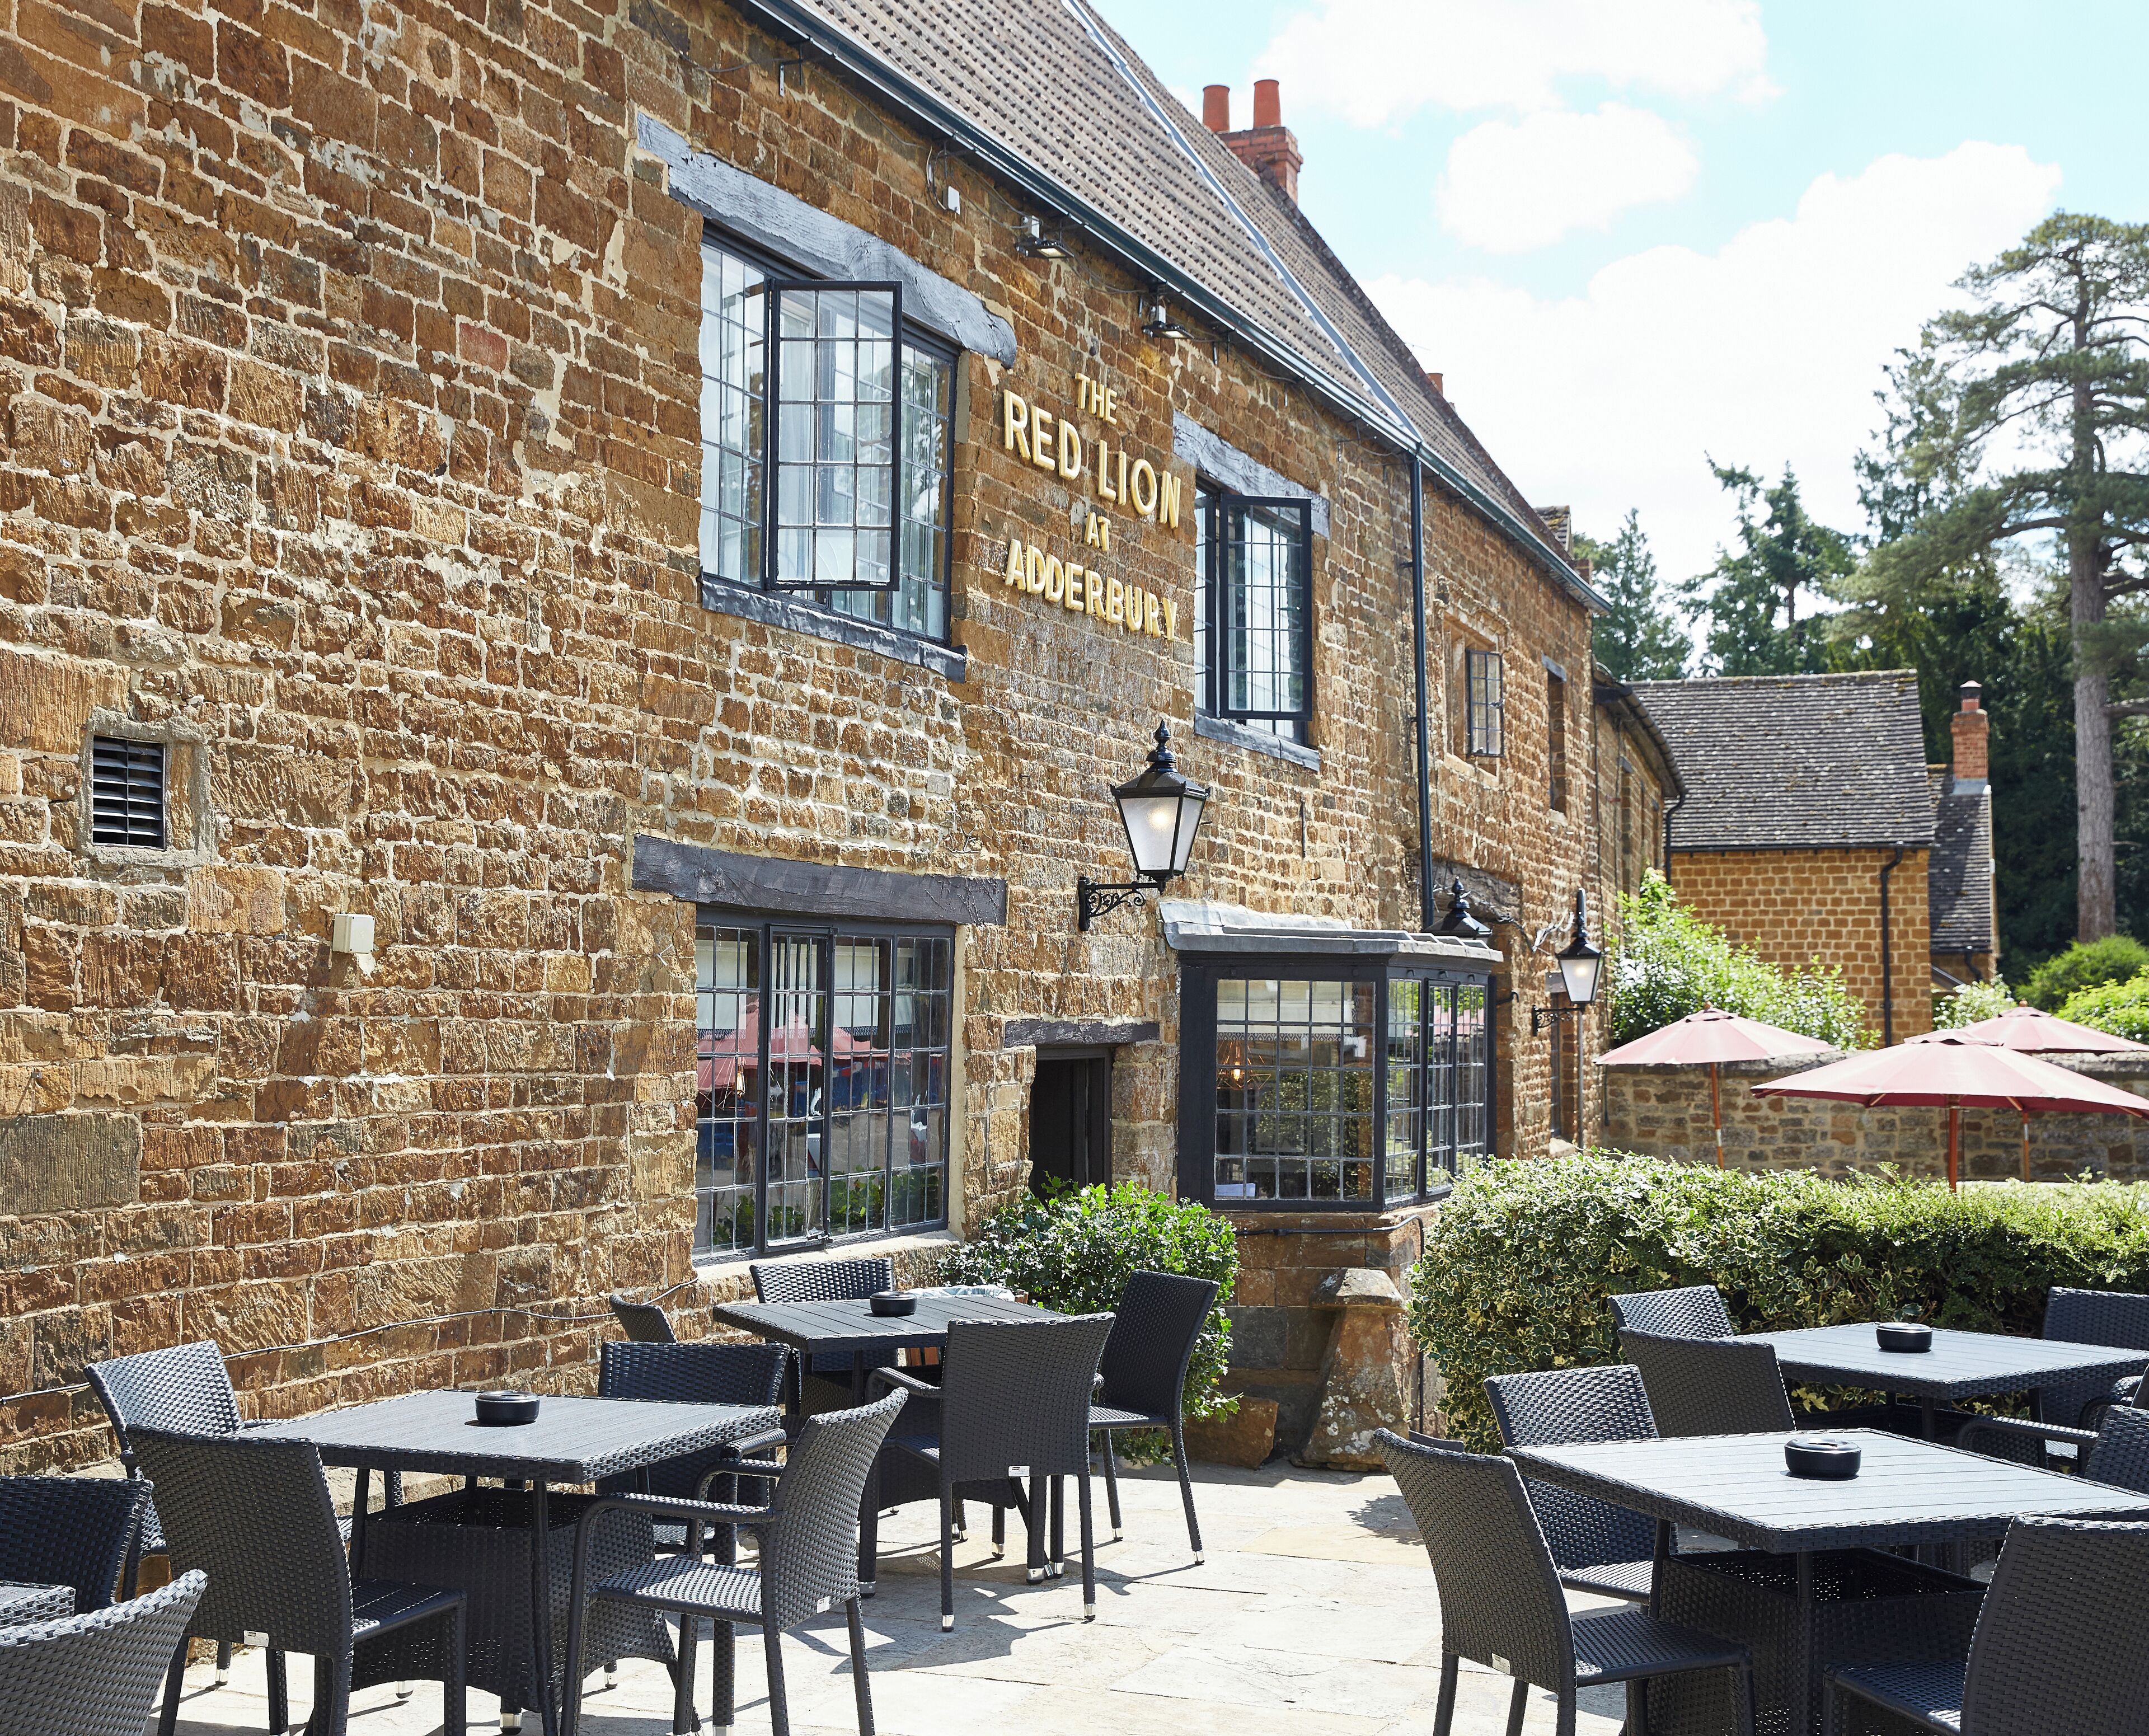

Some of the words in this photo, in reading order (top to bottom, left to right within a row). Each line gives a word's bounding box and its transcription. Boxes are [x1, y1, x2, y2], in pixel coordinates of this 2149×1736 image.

[1075, 373, 1117, 425] THE
[1003, 390, 1081, 480] RED
[1098, 439, 1181, 529] LION
[1084, 512, 1110, 551] AT
[1005, 539, 1177, 641] ADDERBURY
